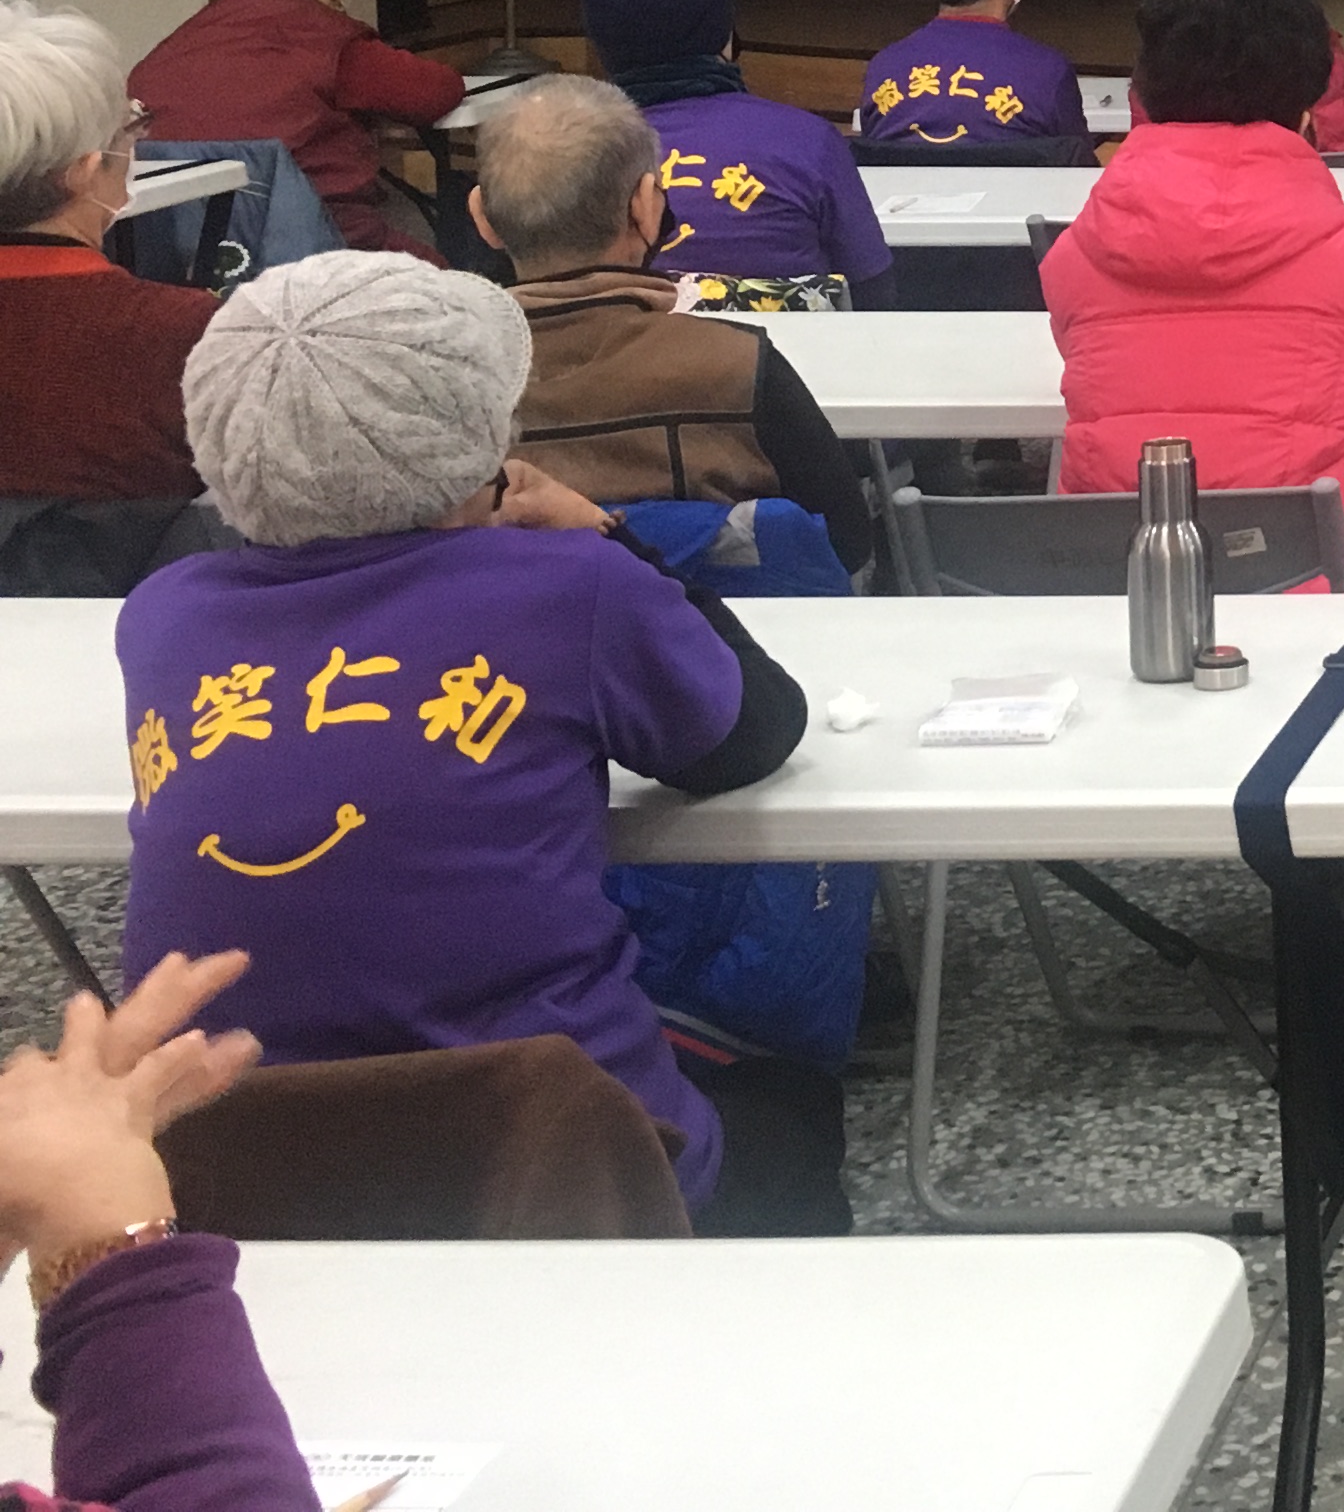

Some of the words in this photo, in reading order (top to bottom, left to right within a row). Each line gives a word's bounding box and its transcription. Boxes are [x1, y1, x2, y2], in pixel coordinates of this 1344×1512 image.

[871, 64, 1025, 125] 微笑仁和
[130, 646, 528, 816] 微笑仁和
